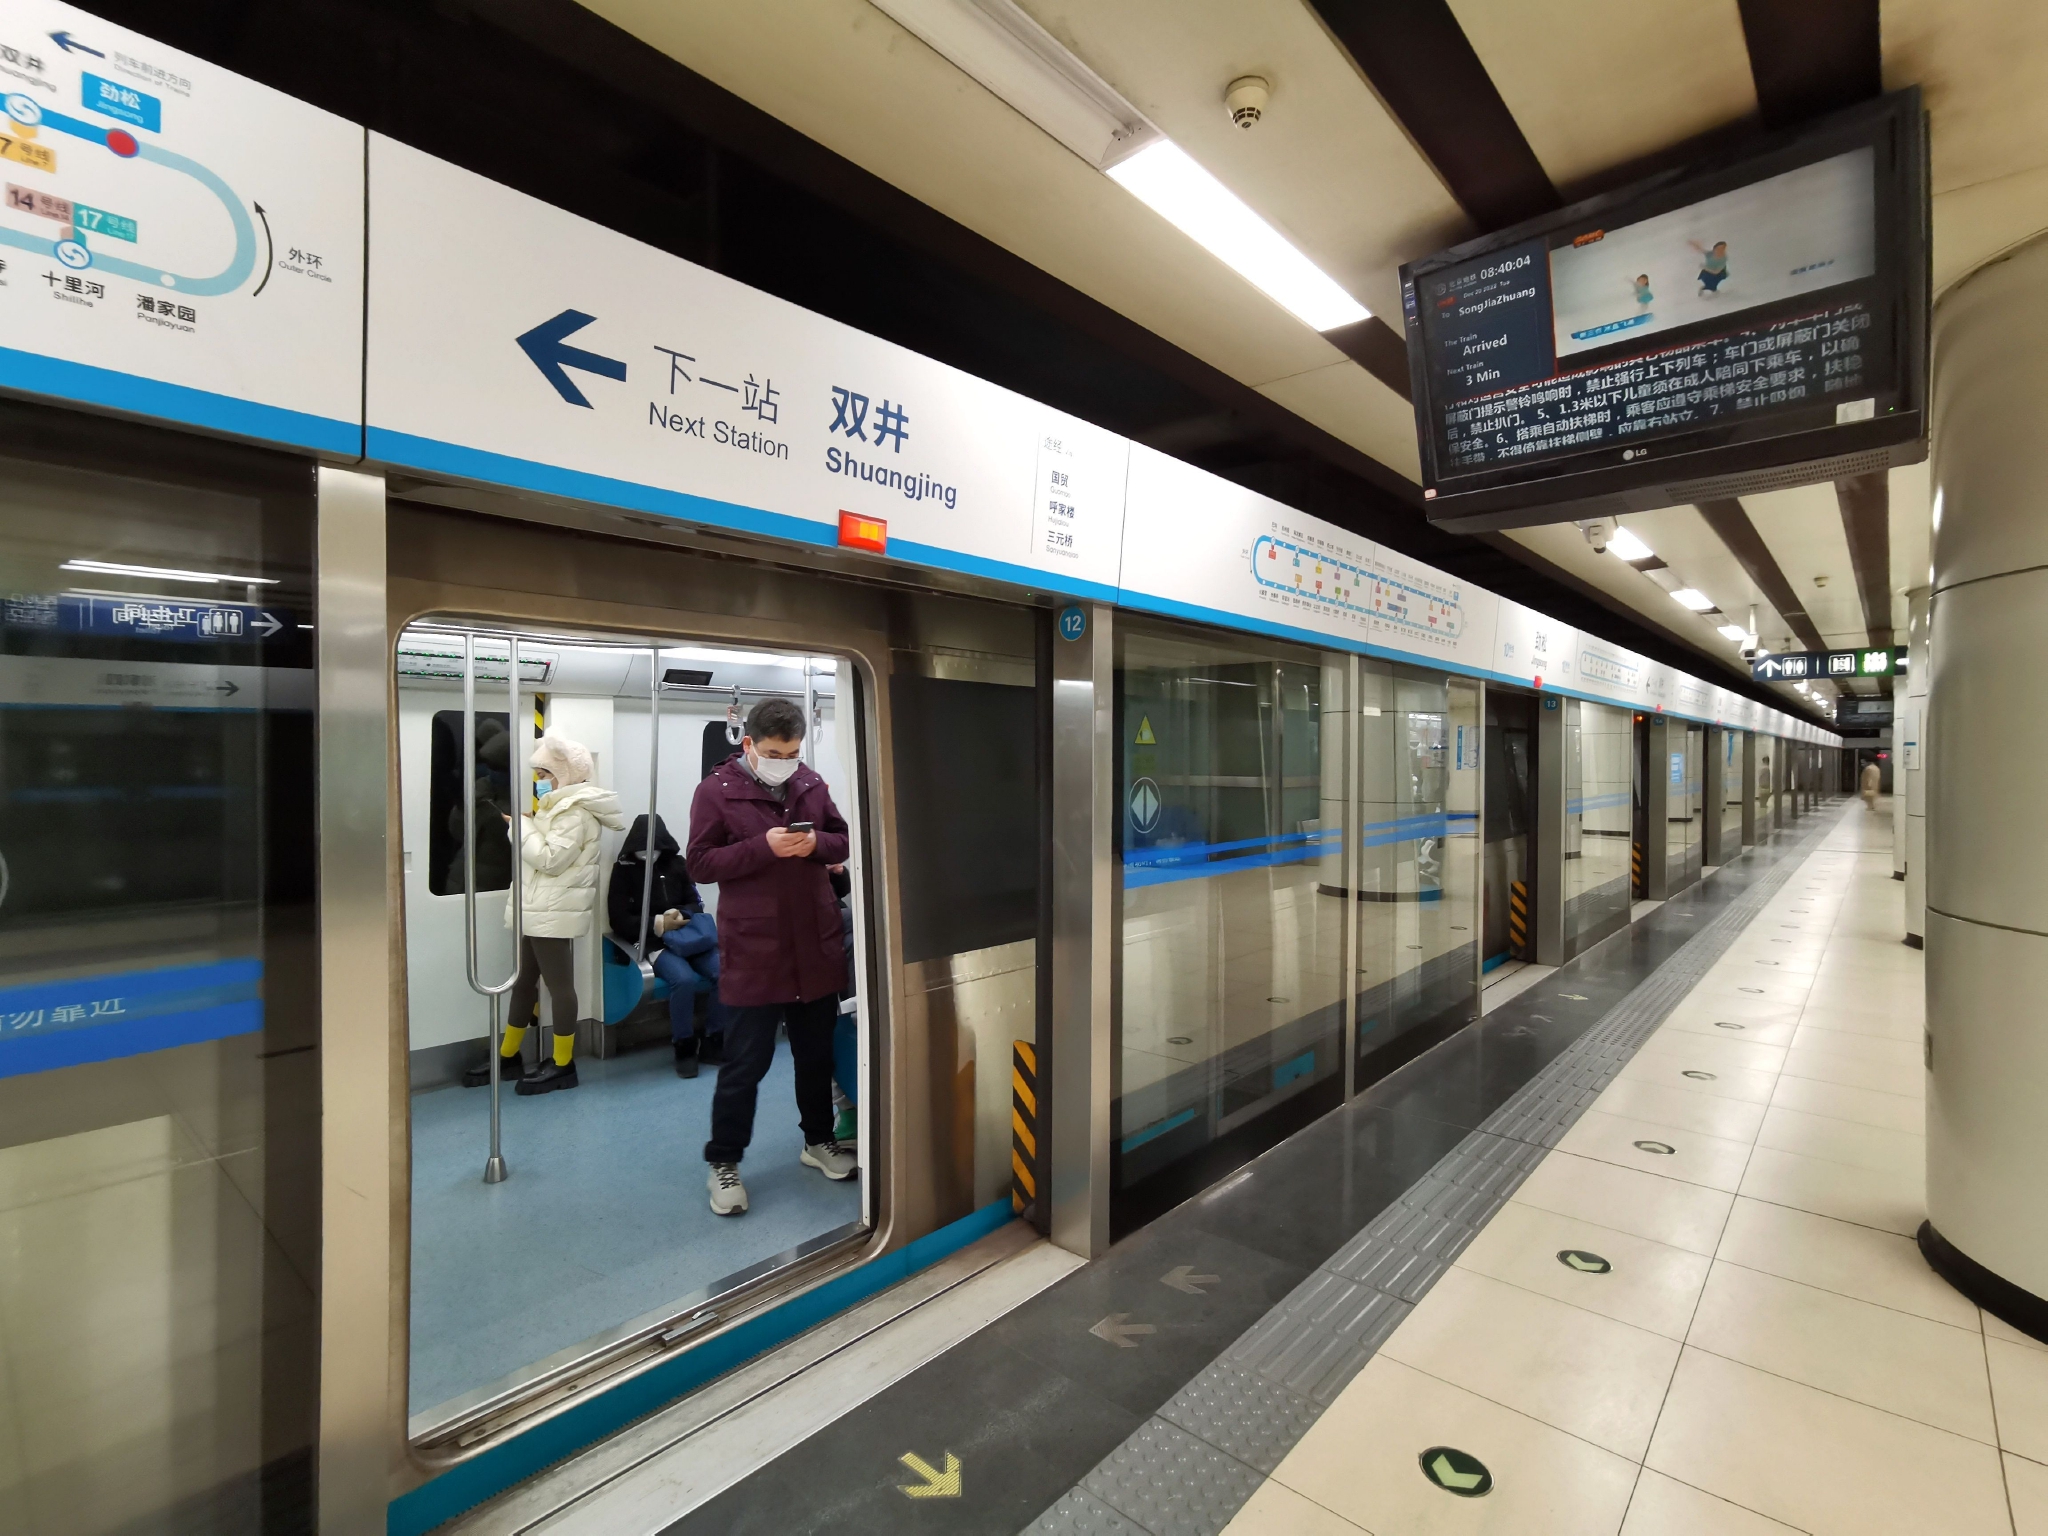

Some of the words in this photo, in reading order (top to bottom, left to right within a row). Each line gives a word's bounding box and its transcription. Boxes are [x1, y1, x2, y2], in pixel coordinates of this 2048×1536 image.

[99, 80, 141, 110] 劲松
[96, 100, 144, 124] Jingsong
[288, 247, 323, 270] 外环
[1480, 255, 1531, 280] 08:40:04
[279, 260, 304, 277] Outer
[306, 268, 332, 283] Circle
[41, 270, 105, 299] 十里河
[53, 291, 94, 308] Shilihe
[136, 293, 196, 323] 潘家园
[1458, 287, 1536, 316] SongJiaZhuang
[137, 312, 195, 333] Panjiayuan
[1460, 333, 1478, 344] Train
[1463, 334, 1508, 356] Arrived
[1447, 366, 1464, 376] Next
[1466, 361, 1484, 371] Train
[1466, 375, 1473, 386] 3
[1477, 369, 1500, 383] Min
[654, 345, 780, 424] 下一站
[829, 385, 909, 453] 双井
[649, 401, 706, 440] Next
[713, 420, 788, 460] Station
[825, 447, 957, 510] Shuangjing
[1635, 448, 1647, 457] LG
[1051, 470, 1069, 487] 国贸
[1049, 500, 1075, 518] 呼家楼
[1047, 530, 1073, 548] 三元桥
[1064, 615, 1082, 633] 12
[1546, 700, 1556, 708] 13
[0, 997, 126, 1032] 勿靠近
